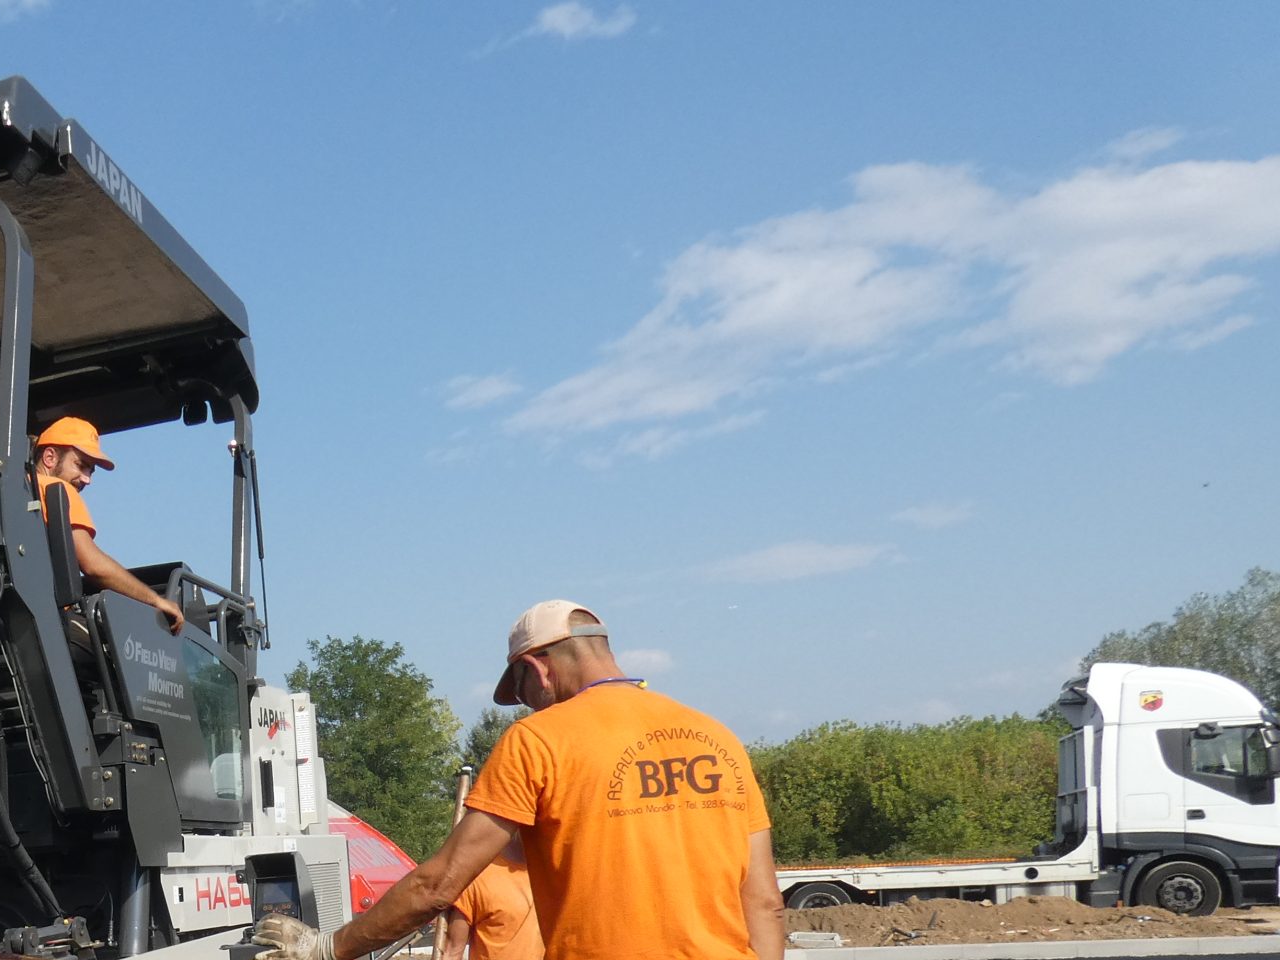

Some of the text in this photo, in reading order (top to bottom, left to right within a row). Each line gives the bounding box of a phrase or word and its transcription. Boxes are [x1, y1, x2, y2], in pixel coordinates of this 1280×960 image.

[86, 140, 143, 224] JAPAN
[135, 641, 177, 673] FIELD VIEW
[148, 671, 184, 699] MONITOR
[258, 706, 287, 731] JAPAN
[607, 746, 637, 800] ASFALTI
[645, 728, 745, 794] PAVIMENTAZIONI
[635, 754, 723, 798] BFG
